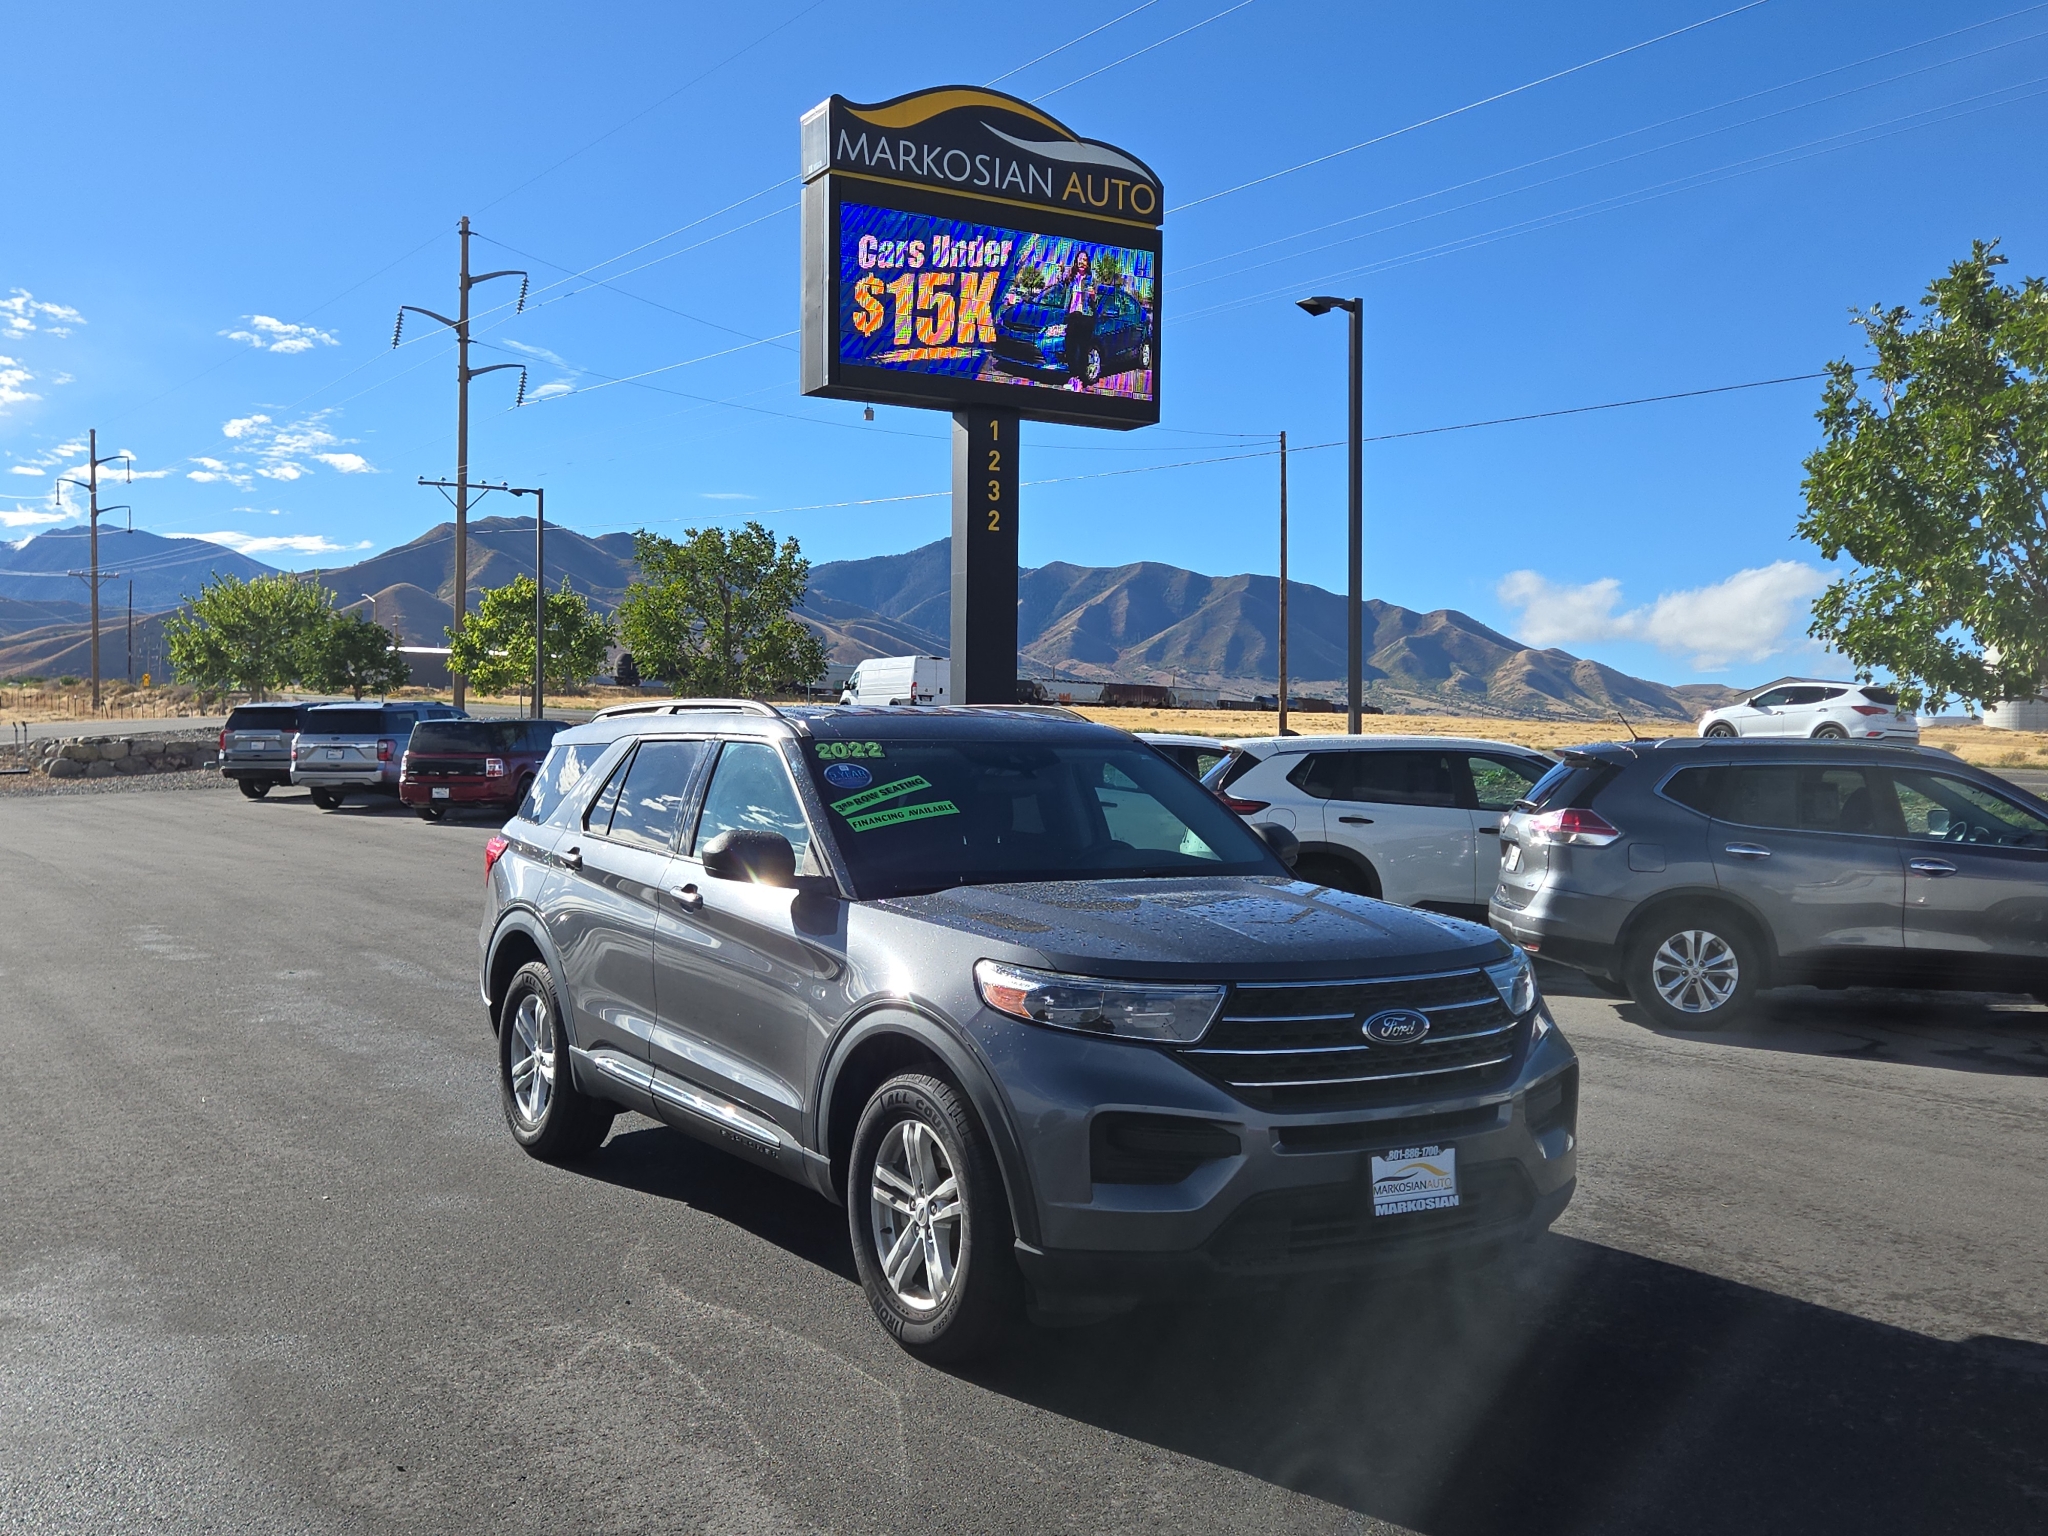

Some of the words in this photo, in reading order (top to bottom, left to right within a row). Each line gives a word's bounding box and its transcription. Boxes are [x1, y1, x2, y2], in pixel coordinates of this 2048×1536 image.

[836, 128, 1052, 199] MARKOSIAN
[1062, 171, 1156, 215] AUTO
[858, 234, 925, 269] Cars
[932, 234, 1012, 268] Under
[852, 272, 1000, 345] $15K
[815, 741, 885, 760] 2022
[854, 791, 879, 806] ROW
[878, 778, 926, 796] SEATING
[851, 811, 905, 829] FINANCING
[908, 803, 955, 817] AVAILABLE
[1381, 1016, 1416, 1038] Ford
[886, 1091, 909, 1107] ALL
[1375, 1194, 1460, 1217] MARKOSIAN
